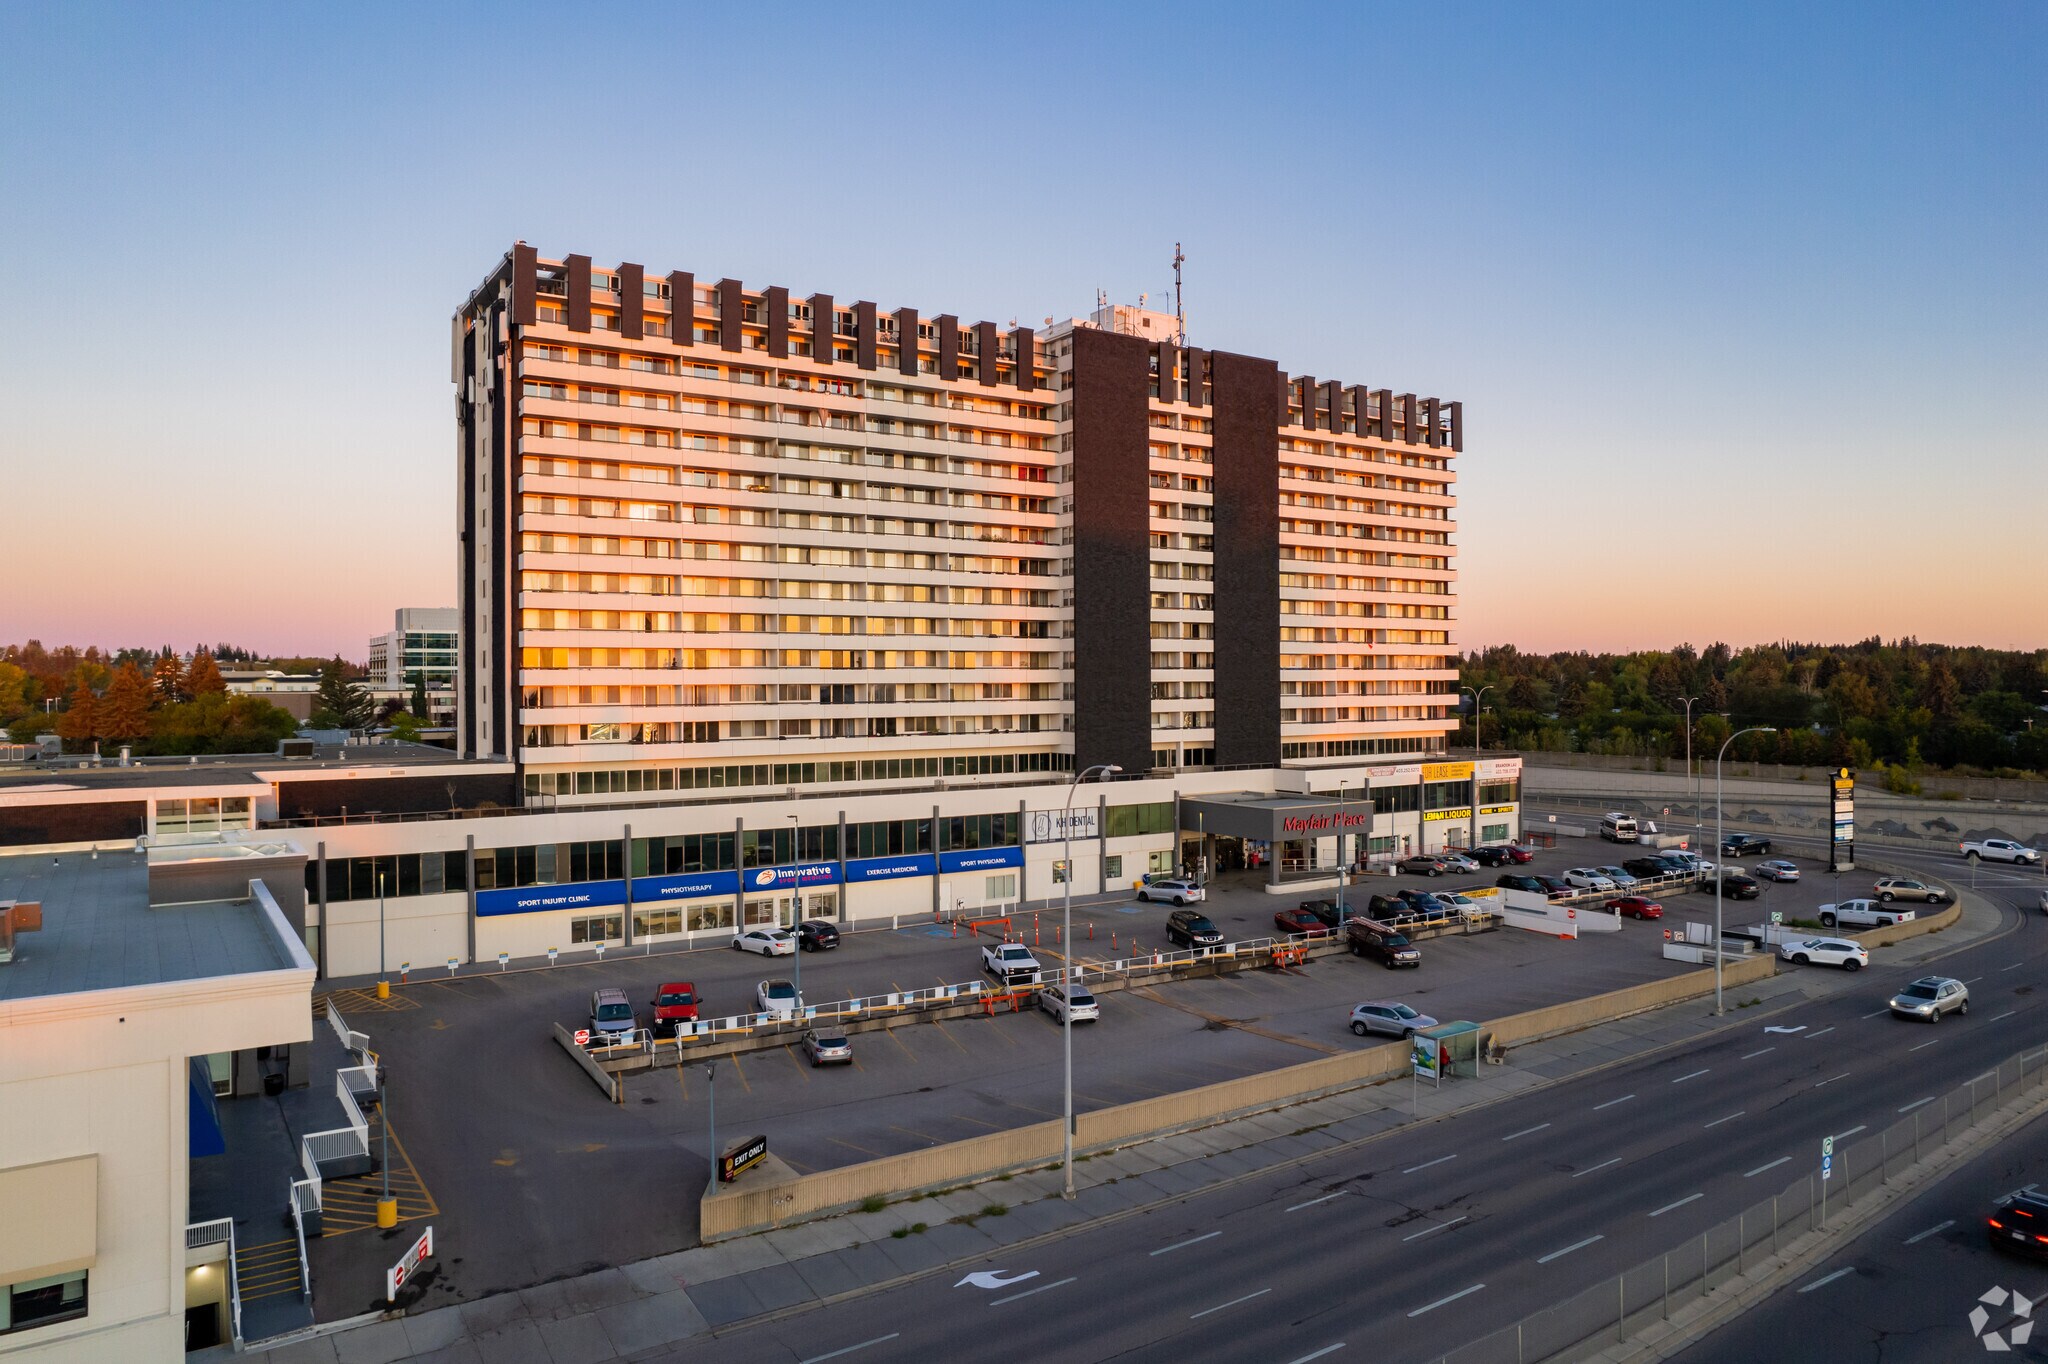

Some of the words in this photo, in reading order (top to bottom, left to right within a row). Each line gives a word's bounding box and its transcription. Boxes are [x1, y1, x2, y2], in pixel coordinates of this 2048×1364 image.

[1422, 766, 1432, 778] FOR
[1434, 766, 1449, 778] LEASE
[1445, 810, 1471, 819] LIQUOR
[1056, 817, 1067, 828] KH
[1069, 815, 1095, 827] DENTAL
[1283, 813, 1330, 836] Mayfair
[1333, 812, 1366, 828] Place
[777, 866, 831, 878] Innovative
[892, 866, 918, 874] MEDICINE
[661, 884, 712, 894] PHYSIOTHERAPY
[518, 899, 541, 907] SPORT
[542, 897, 567, 905] INJURY
[734, 1152, 748, 1166] EXIT
[748, 1142, 765, 1157] ONLY
